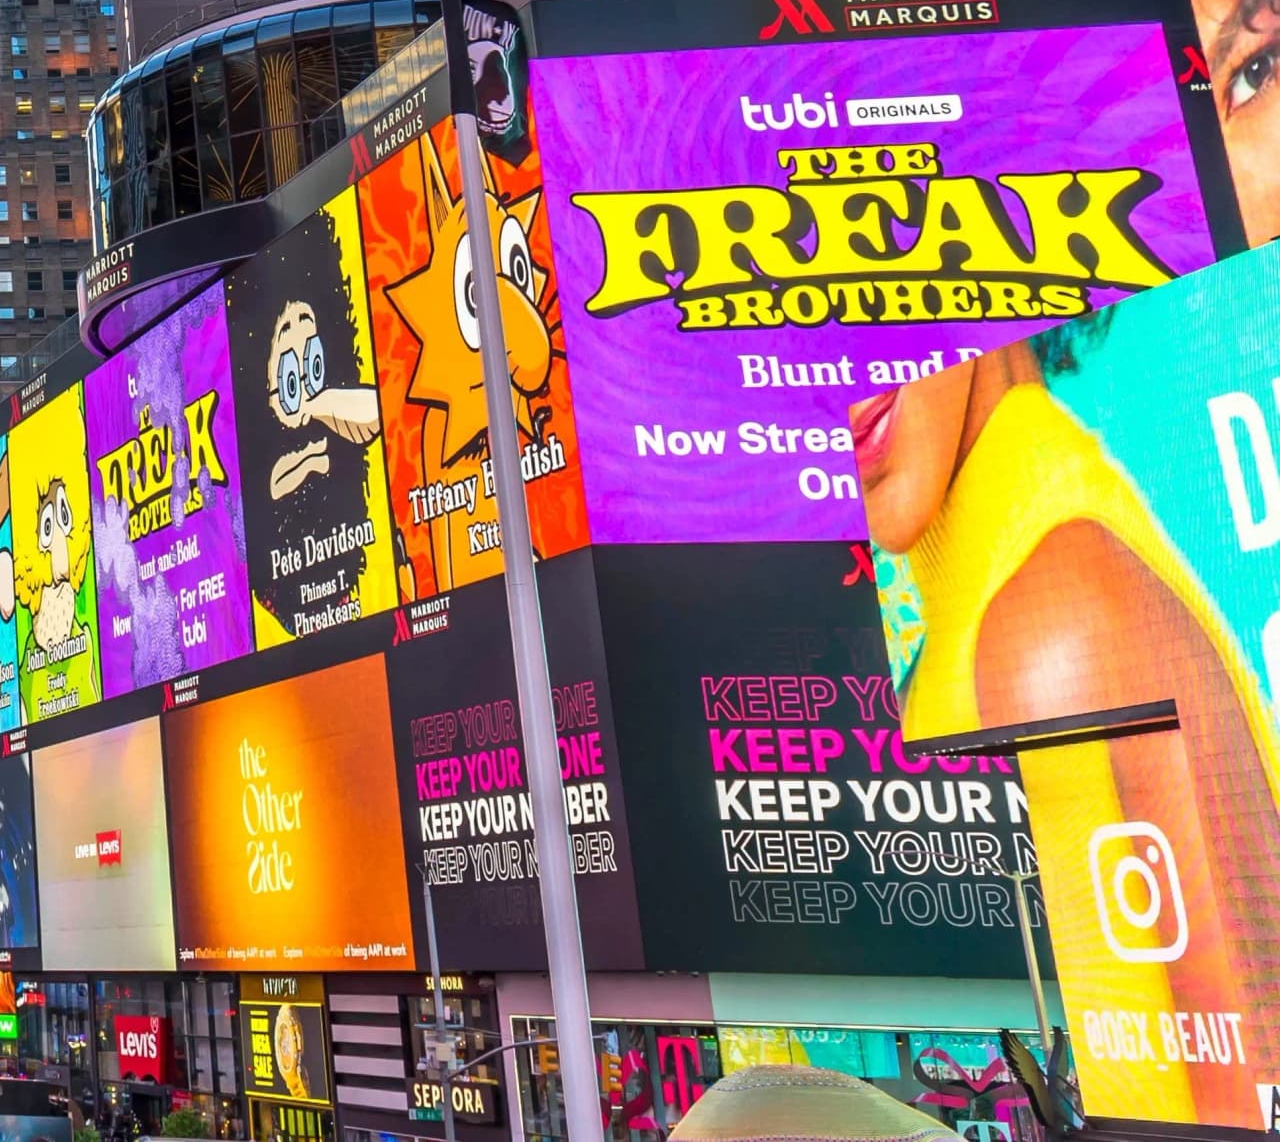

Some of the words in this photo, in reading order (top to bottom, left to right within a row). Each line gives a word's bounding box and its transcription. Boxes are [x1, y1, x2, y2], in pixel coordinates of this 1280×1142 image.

[850, 1, 996, 26] MARQUIS
[374, 87, 428, 140] MARRIOTT
[741, 92, 839, 131] tubi
[856, 102, 952, 121] ORIGINALS
[375, 113, 424, 159] MARQUIS
[777, 143, 940, 183] THE
[86, 242, 134, 283] MARRIOTT
[572, 168, 1176, 317] FREAK
[88, 267, 128, 304] MARQUIS
[680, 279, 1092, 331] BROTHERS
[21, 372, 47, 400] MARRIOTT
[738, 355, 855, 388] Blunt
[867, 351, 944, 385] and
[634, 425, 727, 457] Now
[739, 422, 854, 455] Strea
[409, 476, 478, 525] Tiffany
[481, 435, 566, 498] Hdish
[799, 468, 858, 499] On
[271, 547, 302, 579] Pete
[304, 519, 375, 568] Davidson
[468, 522, 503, 555] Kitt
[180, 588, 197, 613] For
[199, 573, 226, 606] FREE
[300, 577, 337, 604] Phineas
[337, 569, 350, 592] T.
[113, 615, 131, 638] Now
[294, 598, 361, 637] Phreakears
[411, 596, 450, 619] MARRIOTT
[412, 615, 448, 635] MARQUIS
[183, 615, 207, 647] tubi
[27, 650, 45, 673] John
[47, 633, 87, 663] Goodman
[701, 676, 837, 722] KEEP
[411, 714, 457, 757] KEEP
[458, 700, 517, 748] YOUR
[552, 682, 598, 731] ONE
[239, 737, 267, 779] the
[416, 757, 462, 800] KEEP
[463, 747, 522, 793] YOUR
[556, 732, 605, 780] ONE
[709, 728, 845, 773] KEEP
[242, 782, 303, 837] Other
[420, 803, 463, 842] KEEP
[465, 795, 518, 837] YOUR
[520, 782, 610, 832] NBER
[715, 779, 841, 822] KEEP
[846, 779, 996, 824] YOUR
[246, 839, 295, 894] Side
[424, 846, 468, 885] KEEP
[468, 841, 523, 881] YOUR
[525, 831, 617, 878] NBER
[722, 829, 850, 874] KEEP
[855, 830, 1002, 876] YOUR
[730, 880, 857, 924] KEEP
[863, 882, 1011, 927] YOUR
[426, 976, 463, 991] SEHORA
[414, 1083, 484, 1114] SEPORA
